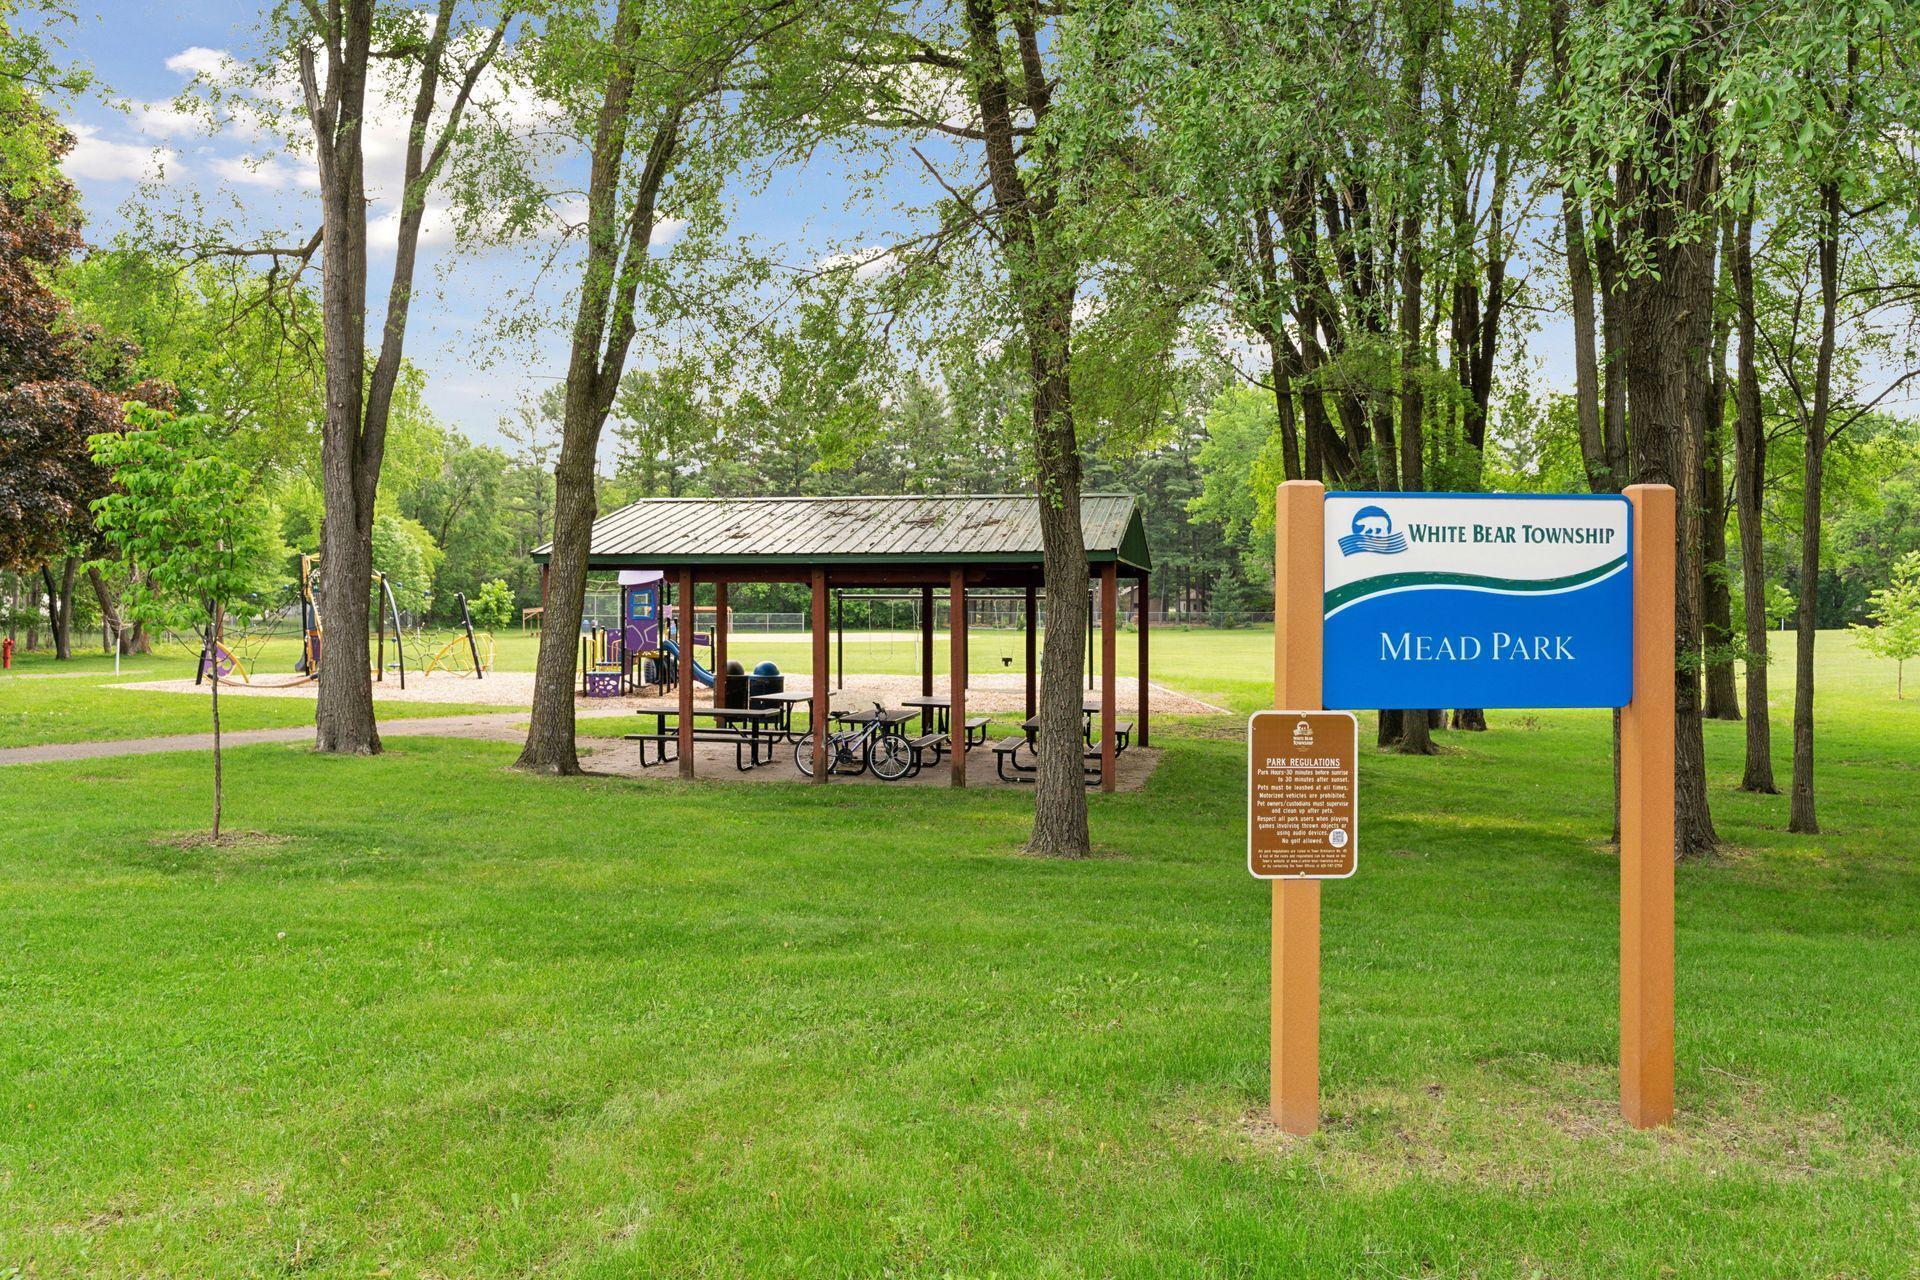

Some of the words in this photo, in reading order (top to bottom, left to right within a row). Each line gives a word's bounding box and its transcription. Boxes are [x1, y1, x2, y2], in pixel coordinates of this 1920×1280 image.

[1408, 523, 1466, 543] WHITE
[1473, 524, 1516, 543] BEAR
[1522, 524, 1615, 544] TOWNSHIP
[1380, 632, 1481, 660] MEAD
[1492, 632, 1576, 660] PARK
[1266, 758, 1286, 766] PARK
[1290, 758, 1340, 766] REGULATIONS
